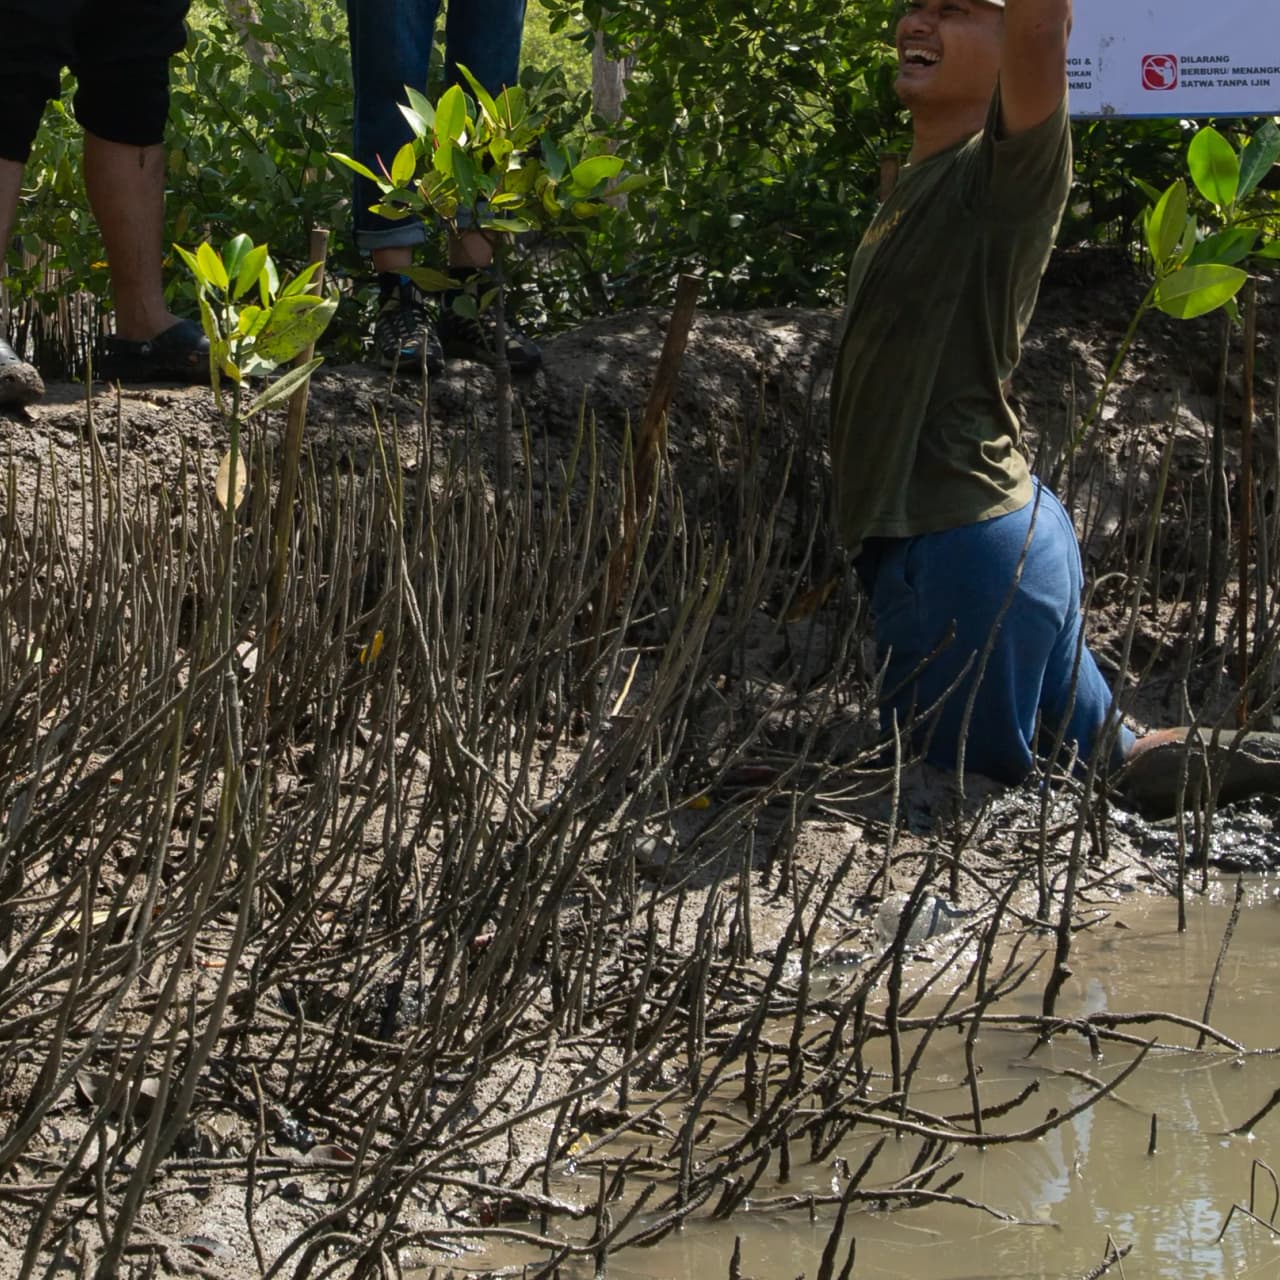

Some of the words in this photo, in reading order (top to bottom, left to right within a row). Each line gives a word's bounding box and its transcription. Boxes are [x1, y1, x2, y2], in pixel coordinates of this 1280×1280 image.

[1181, 55, 1230, 64] DILARANG
[1181, 79, 1215, 88] SATWA
[1217, 78, 1248, 87] TANPA
[1250, 78, 1270, 87] IJIN
